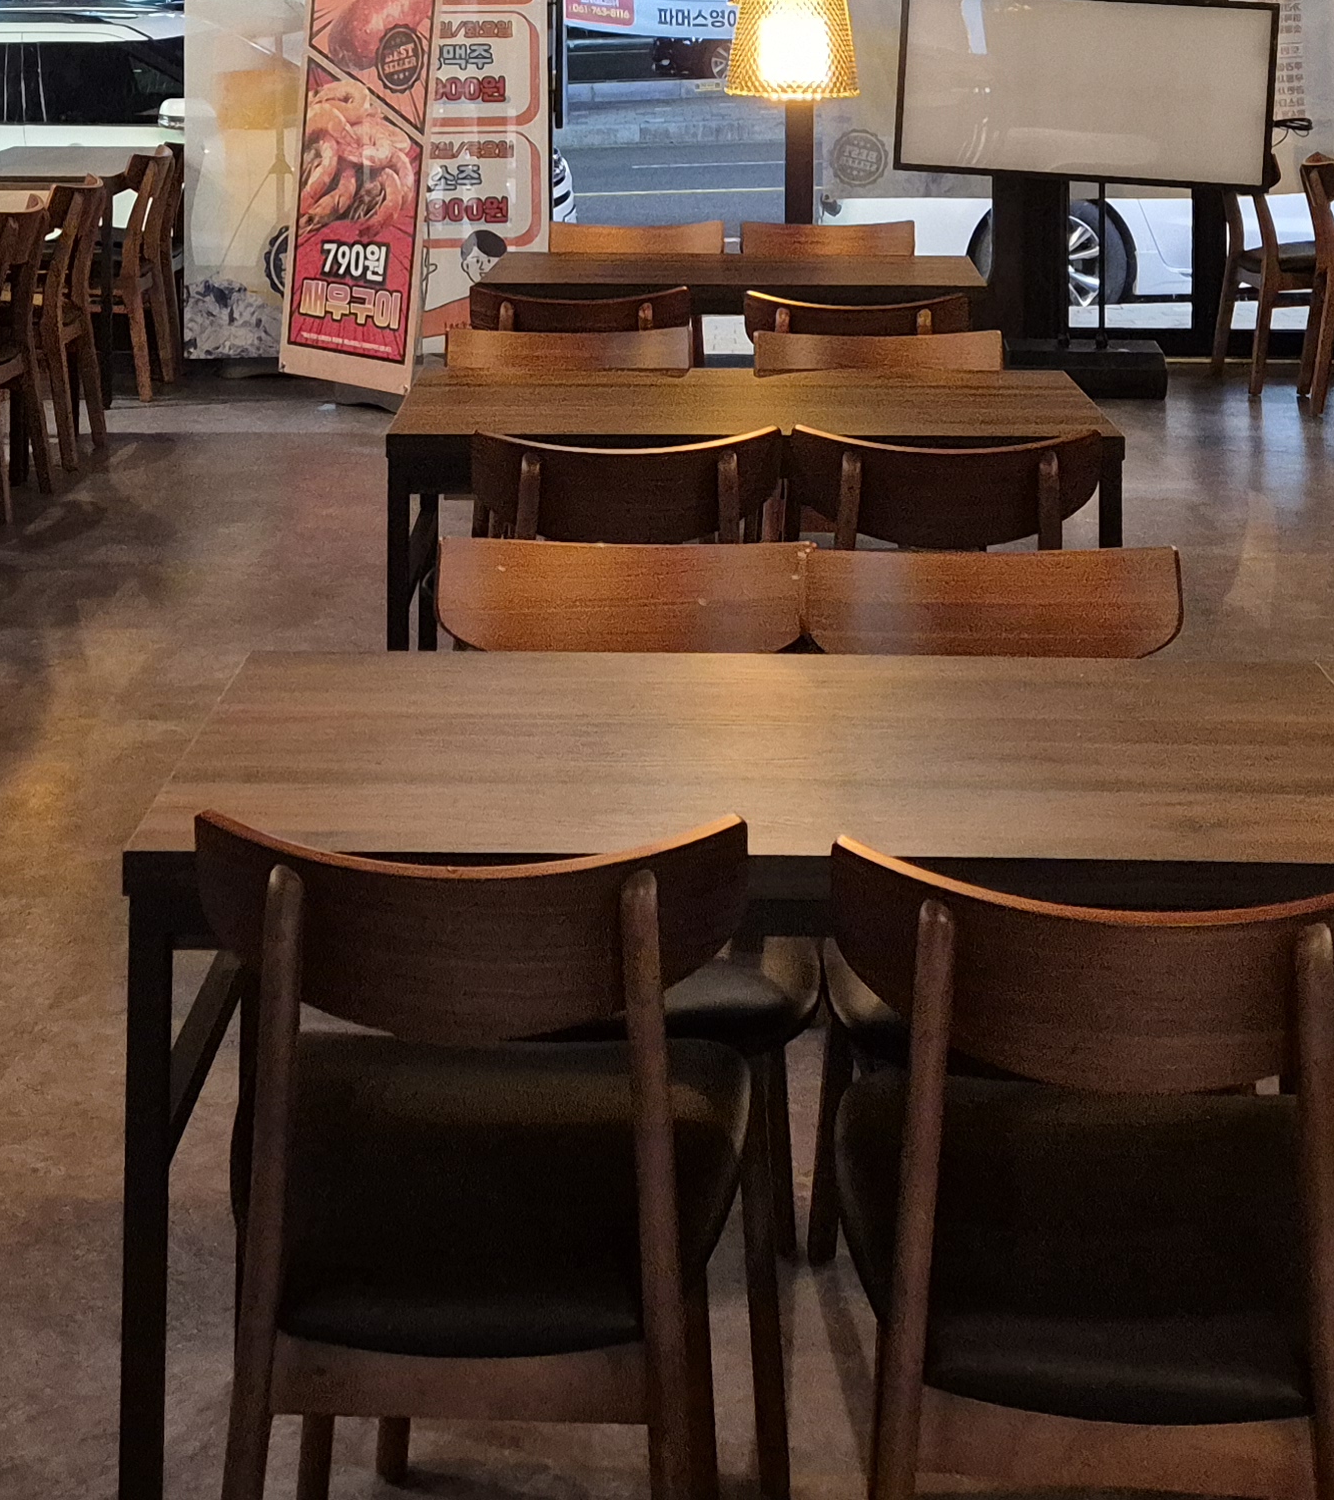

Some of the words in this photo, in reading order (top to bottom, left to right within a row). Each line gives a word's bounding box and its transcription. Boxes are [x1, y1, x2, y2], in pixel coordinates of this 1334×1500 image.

[384, 57, 417, 75] SELLER
[385, 43, 415, 63] BEST
[437, 43, 494, 71] 맥주
[321, 242, 388, 283] 790원
[298, 278, 402, 330] 새우구이
